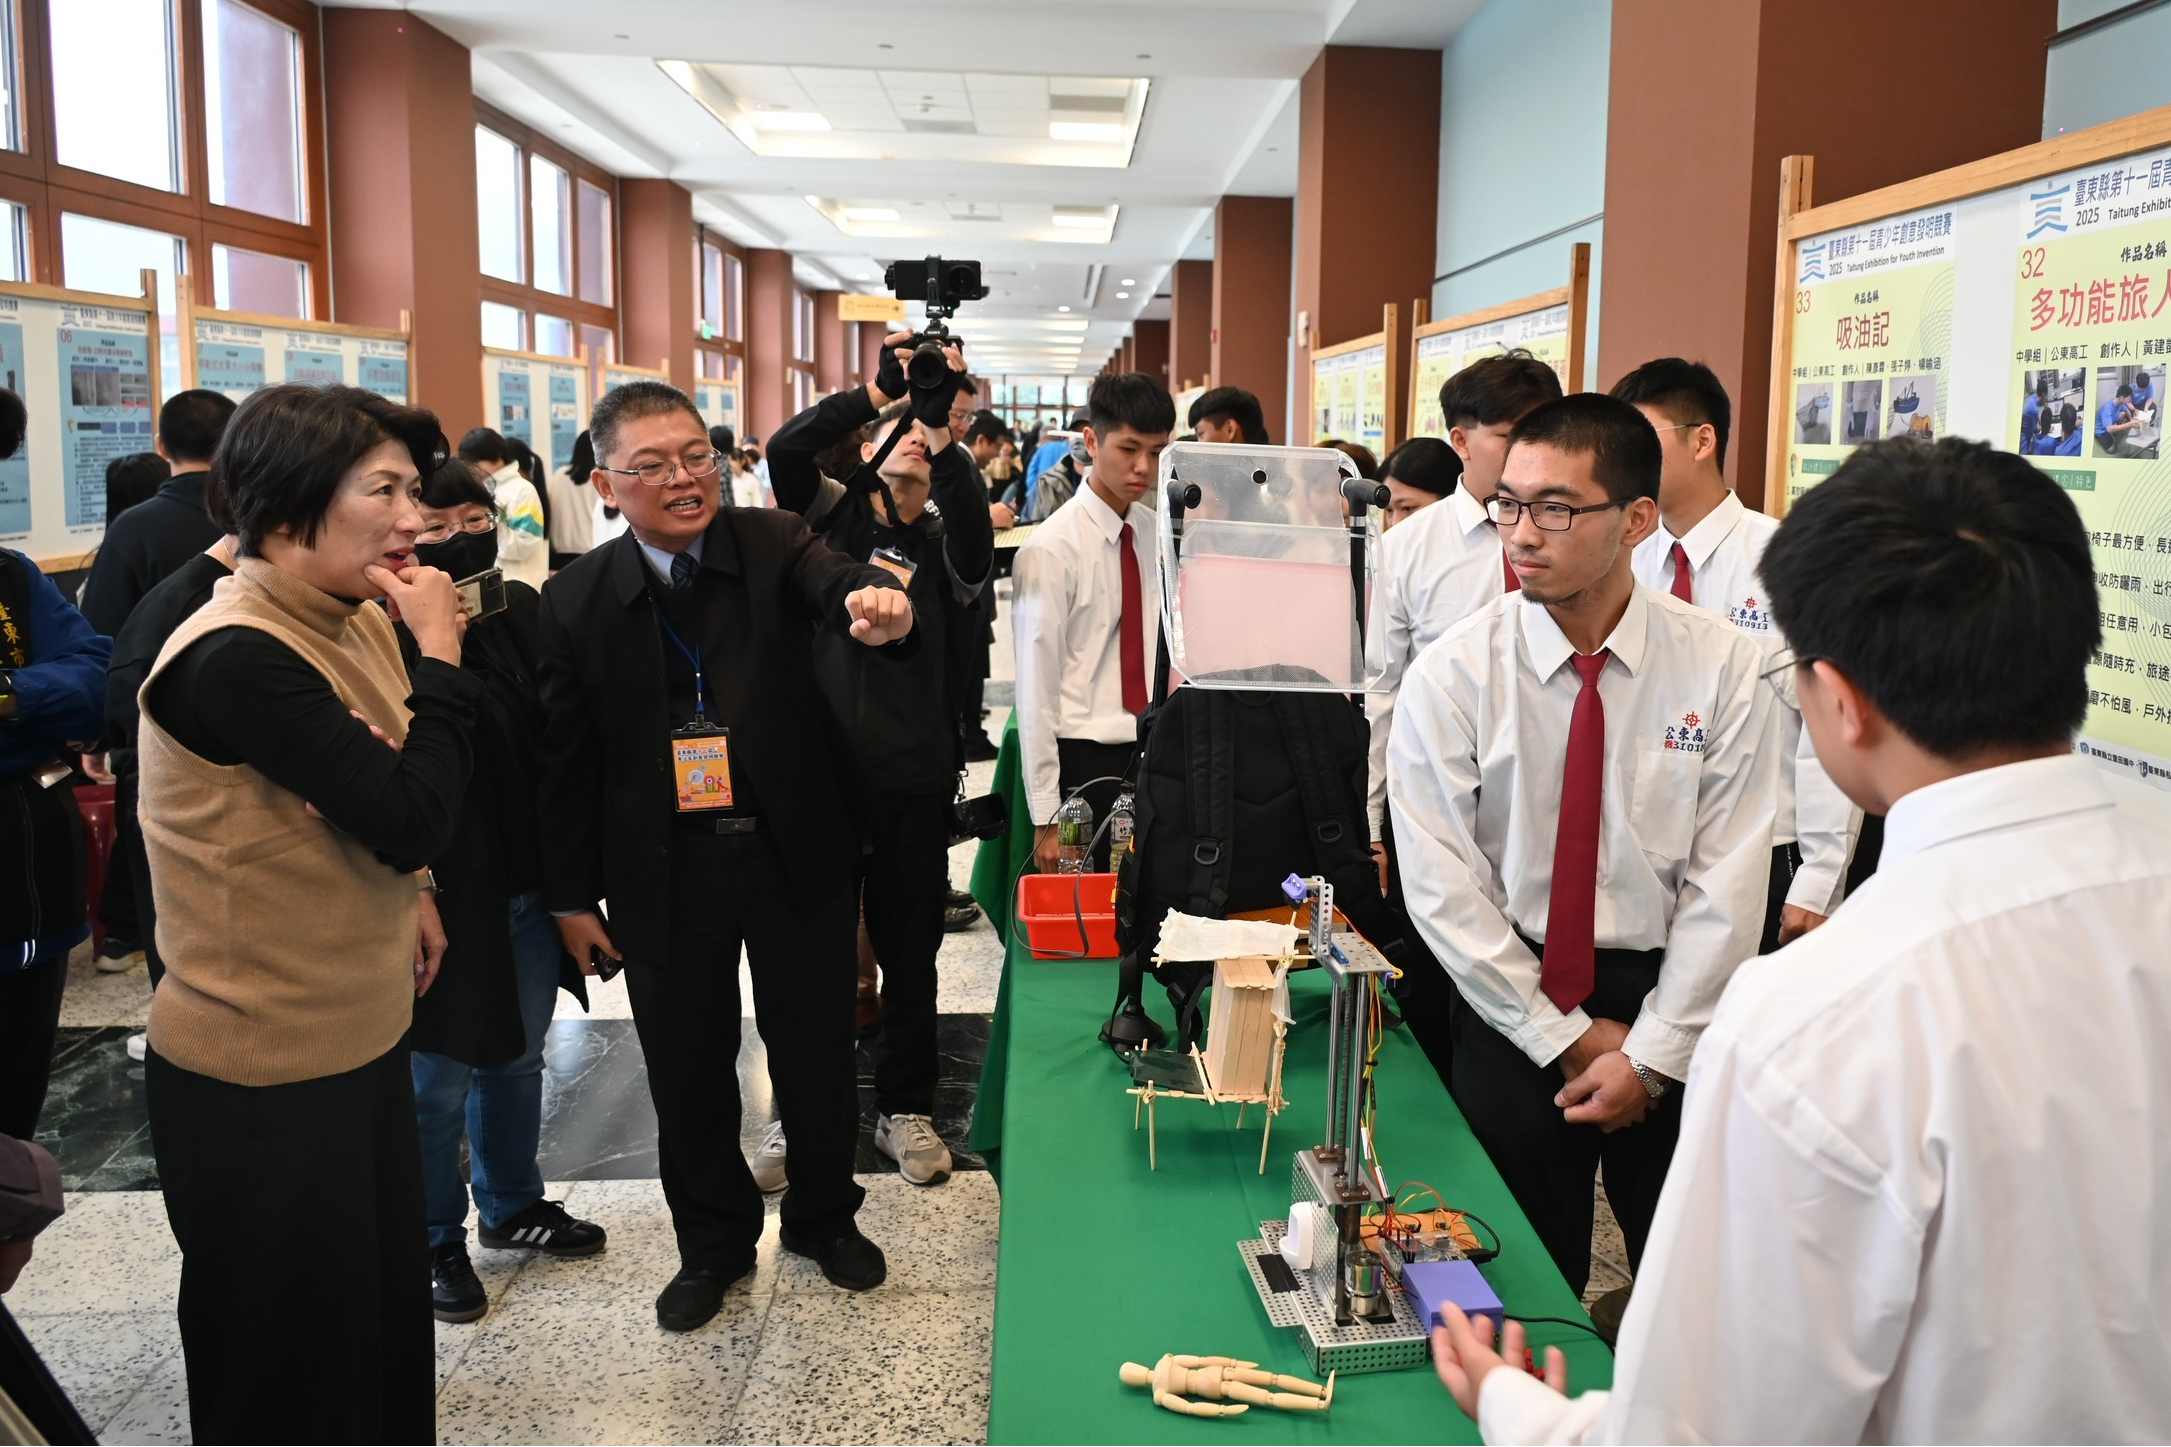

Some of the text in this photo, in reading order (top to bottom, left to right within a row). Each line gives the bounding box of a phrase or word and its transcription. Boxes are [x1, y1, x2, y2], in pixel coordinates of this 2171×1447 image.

[2076, 207, 2099, 226] 2025
[2108, 206, 2139, 220] Taitung
[1829, 246, 1945, 276] 2025 Taitung Exhibition for Youth Invention
[2021, 247, 2045, 279] 32
[2120, 240, 2168, 263] 作品名稱
[1796, 290, 1811, 314] 33
[1854, 290, 1879, 304] 作品名稱
[1836, 311, 1890, 350] 吸油記
[1729, 617, 1769, 630] 310913
